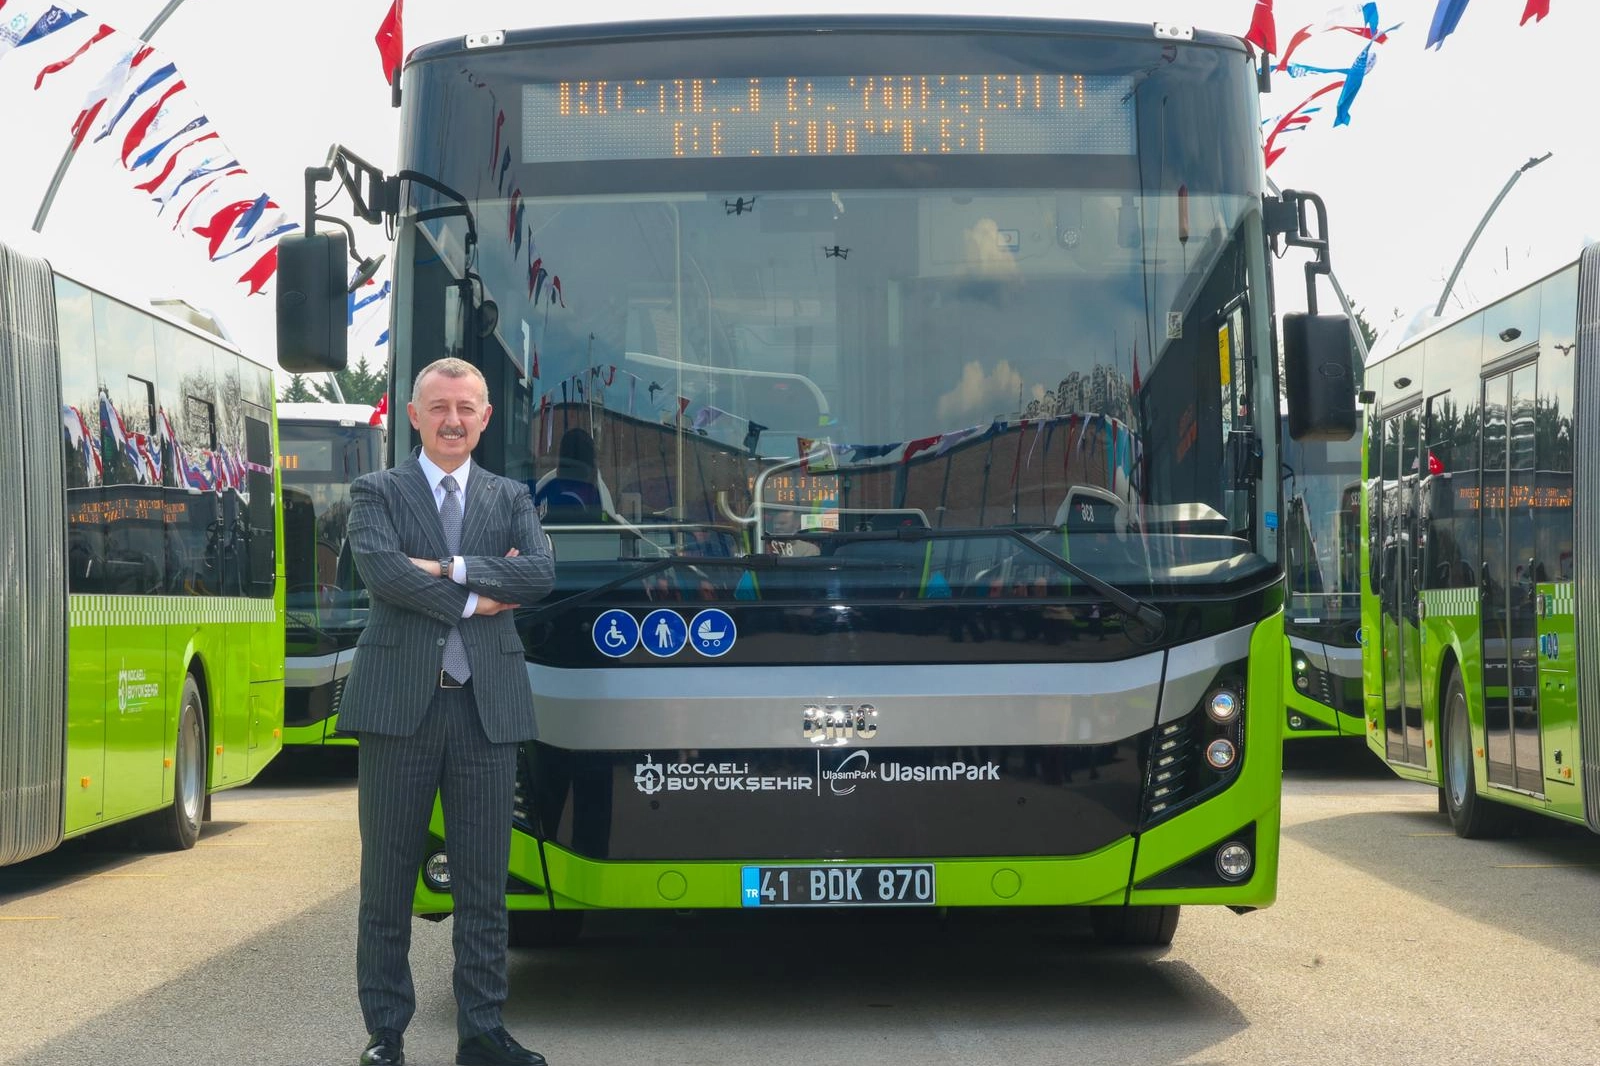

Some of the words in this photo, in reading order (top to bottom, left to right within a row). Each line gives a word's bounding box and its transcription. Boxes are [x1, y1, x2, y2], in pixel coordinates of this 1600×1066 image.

[745, 888, 759, 899] TR
[760, 870, 789, 901] 41
[810, 868, 863, 900] BDK
[878, 868, 931, 900] 870
